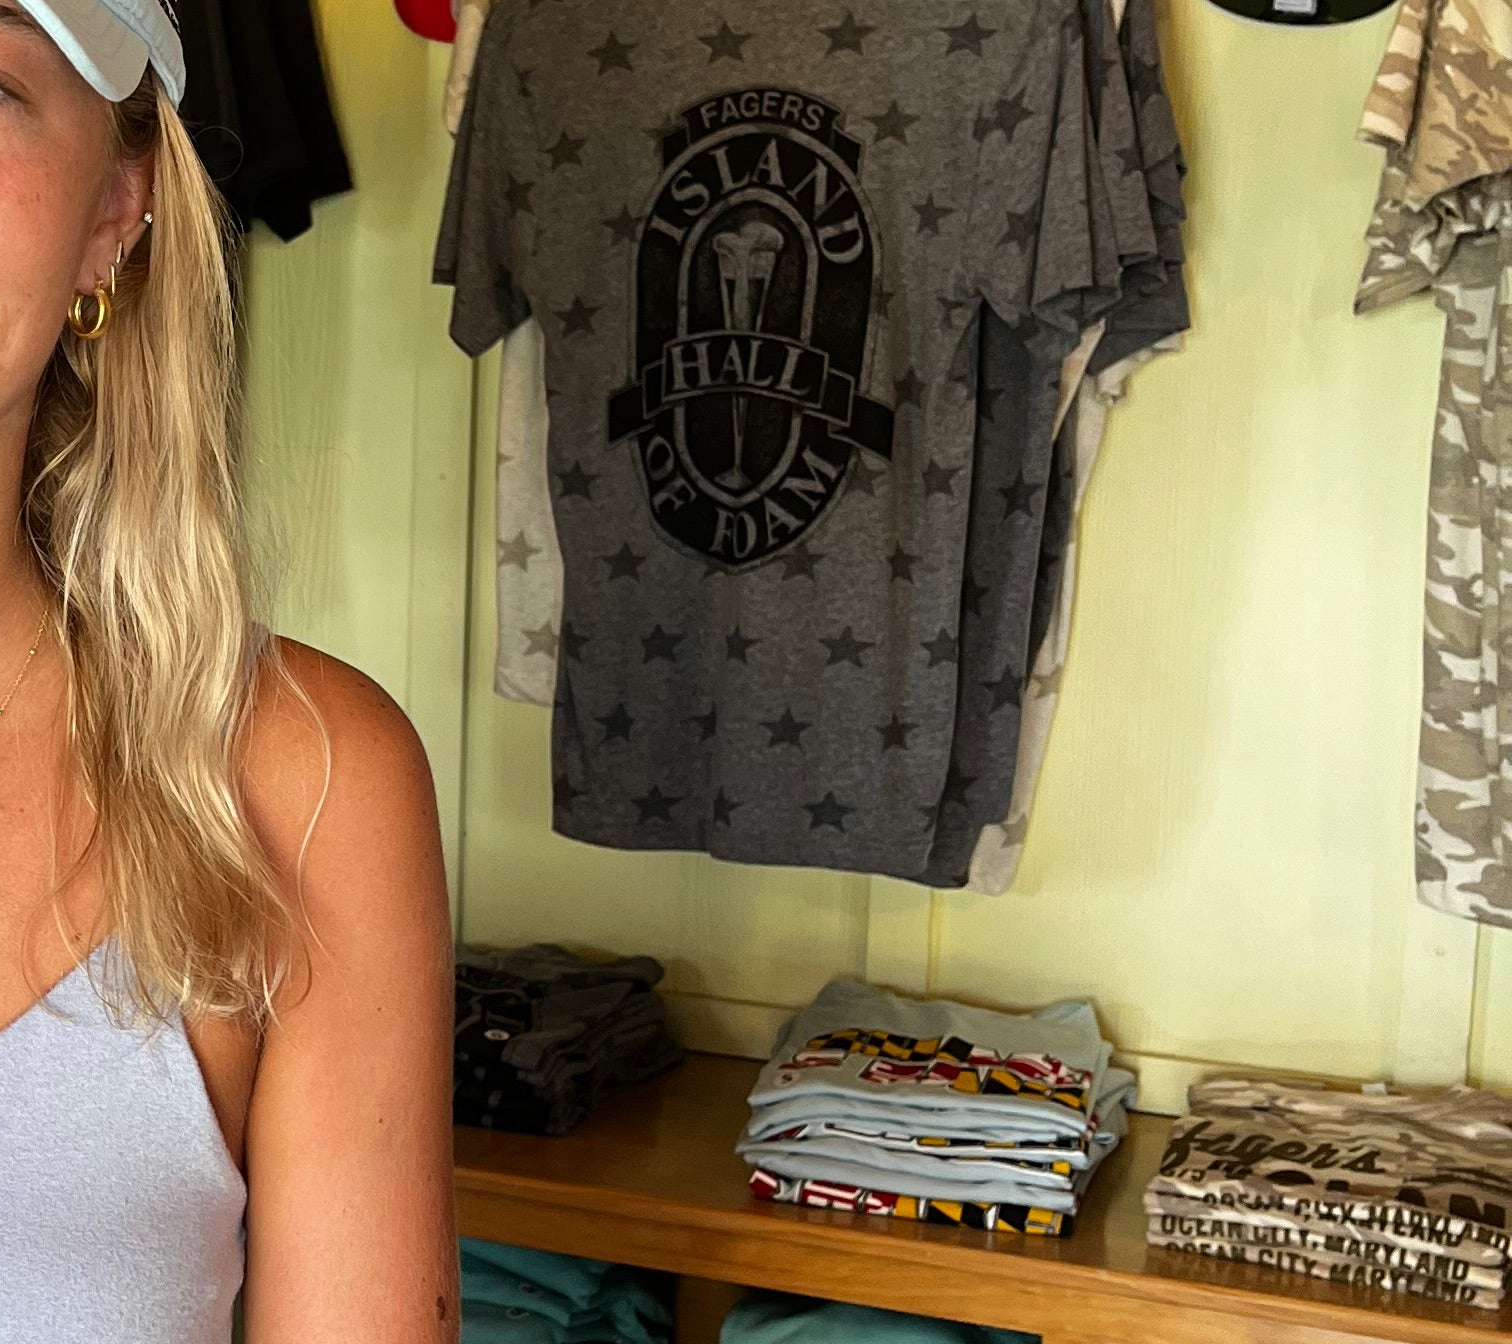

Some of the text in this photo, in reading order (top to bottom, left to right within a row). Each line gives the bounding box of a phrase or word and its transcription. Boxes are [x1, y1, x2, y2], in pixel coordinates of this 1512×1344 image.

[699, 90, 826, 130] FAGERS
[646, 138, 865, 266] ISLAND
[669, 341, 811, 397] HALL
[645, 435, 698, 517] OF
[1161, 1214, 1245, 1239] OCEAN
